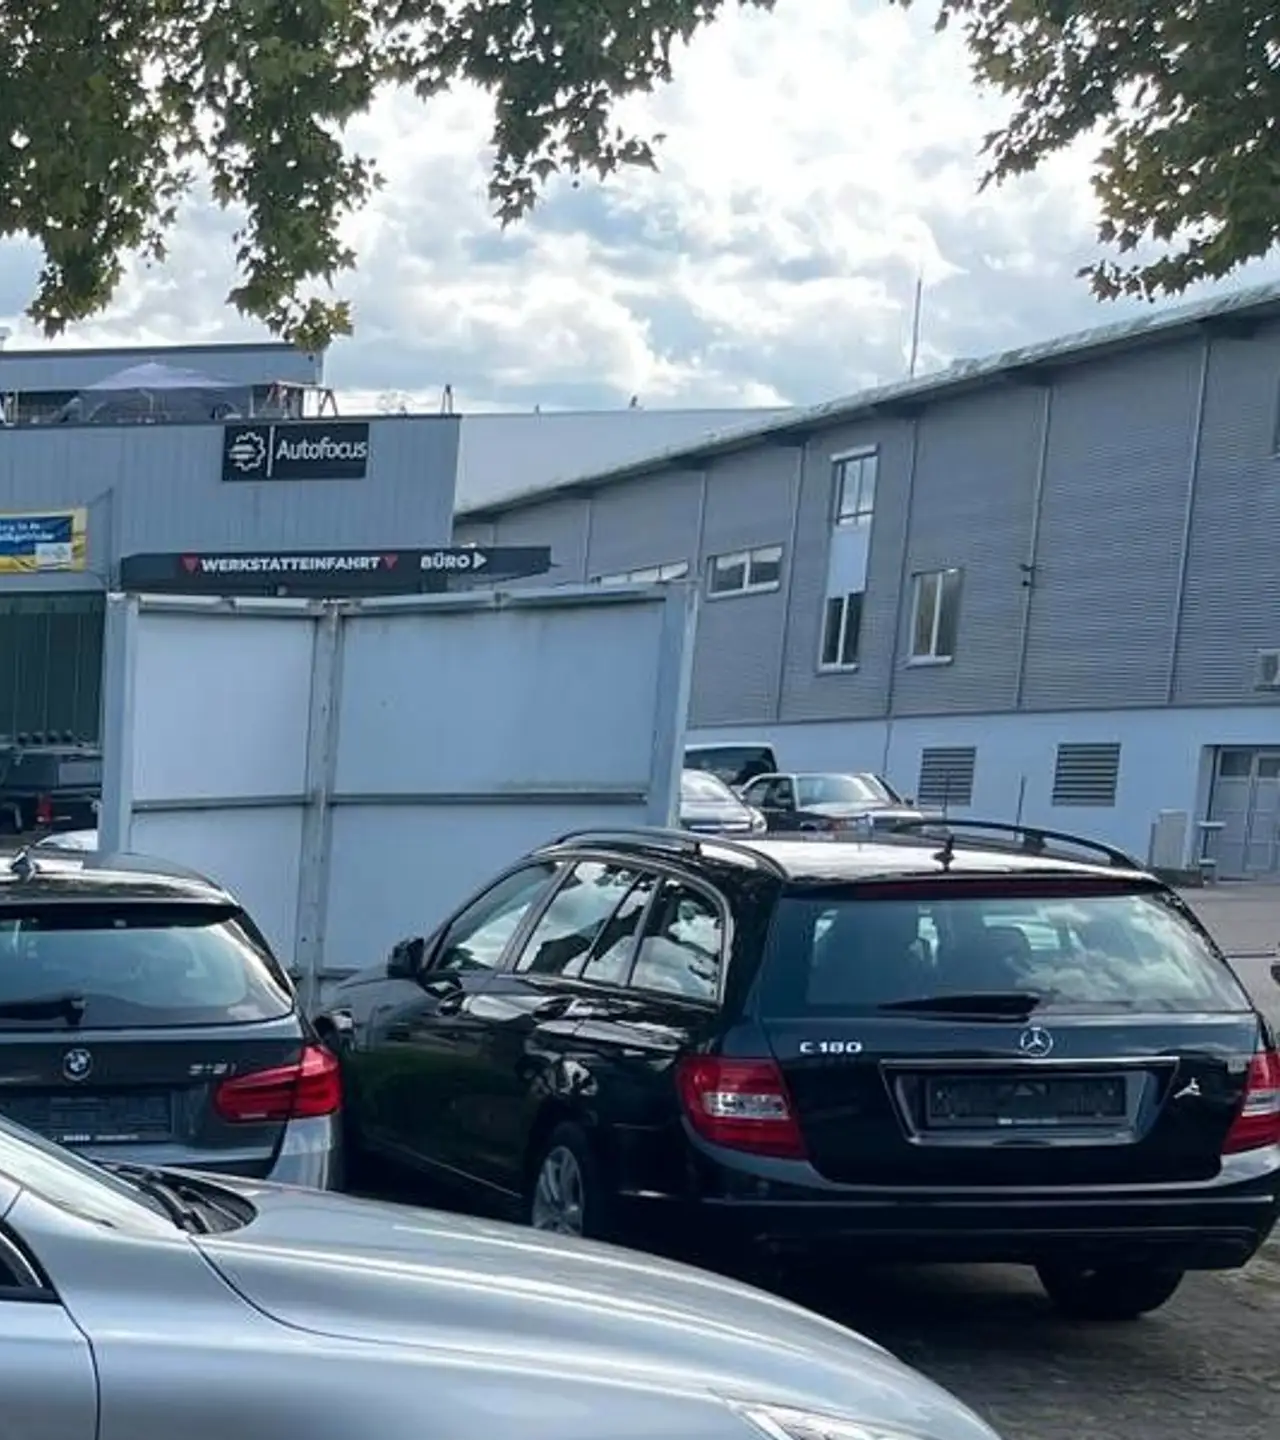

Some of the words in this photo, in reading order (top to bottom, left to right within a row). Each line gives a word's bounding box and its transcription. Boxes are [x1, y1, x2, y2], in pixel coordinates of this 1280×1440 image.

[276, 436, 367, 460] Autofocus
[201, 555, 381, 572] WERKSTATTEINFAHRT
[420, 552, 470, 570] BÜRO
[800, 1041, 814, 1055] C
[819, 1041, 863, 1054] 180
